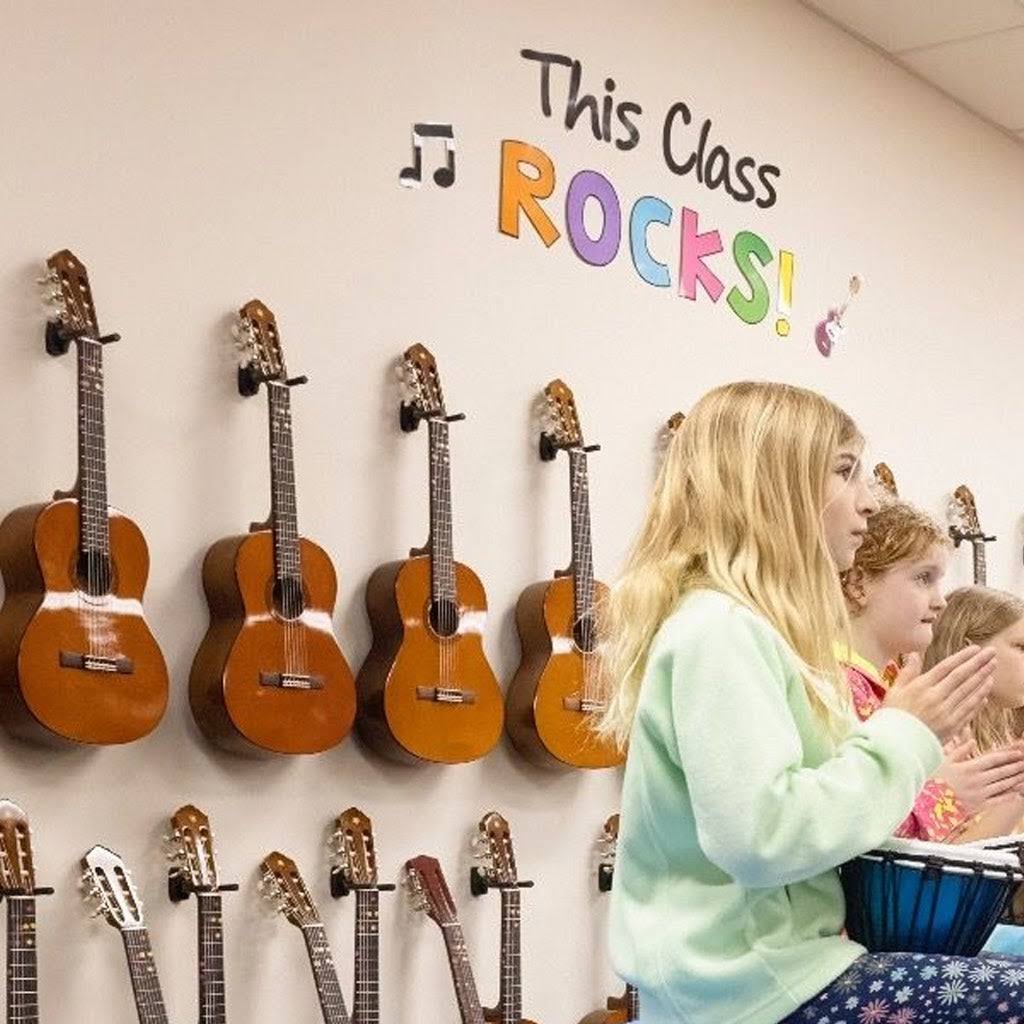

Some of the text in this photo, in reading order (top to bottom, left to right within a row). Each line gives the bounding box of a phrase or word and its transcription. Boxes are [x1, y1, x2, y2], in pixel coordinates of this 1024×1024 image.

[520, 49, 781, 209] This Class
[498, 138, 795, 337] ROCKS!
